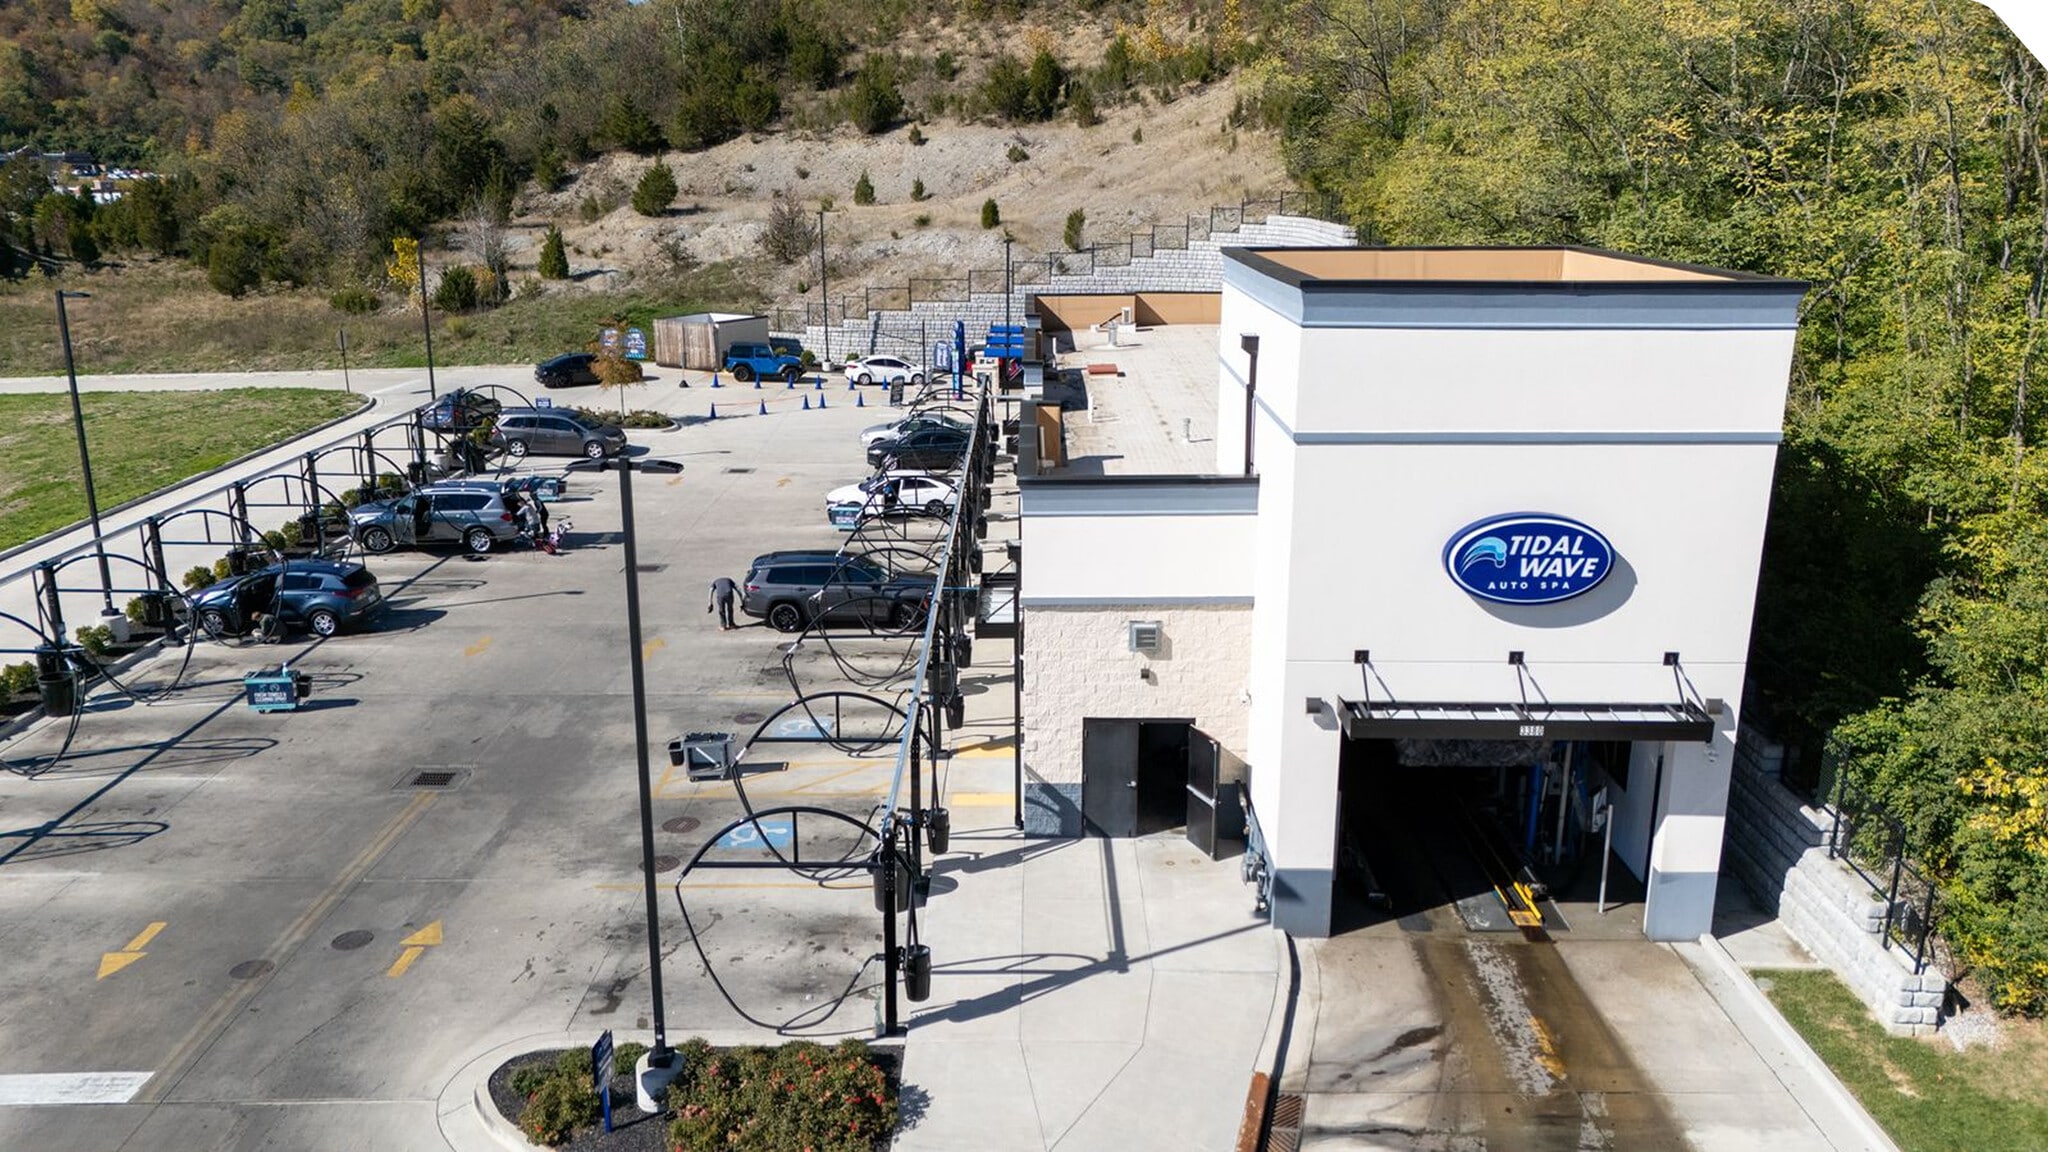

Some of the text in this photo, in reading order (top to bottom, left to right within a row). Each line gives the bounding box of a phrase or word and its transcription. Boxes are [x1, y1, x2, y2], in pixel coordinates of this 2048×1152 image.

[1509, 535, 1584, 556] TIDAL
[1519, 557, 1599, 578] WAVE
[1487, 581, 1570, 590] AUTO SPA
